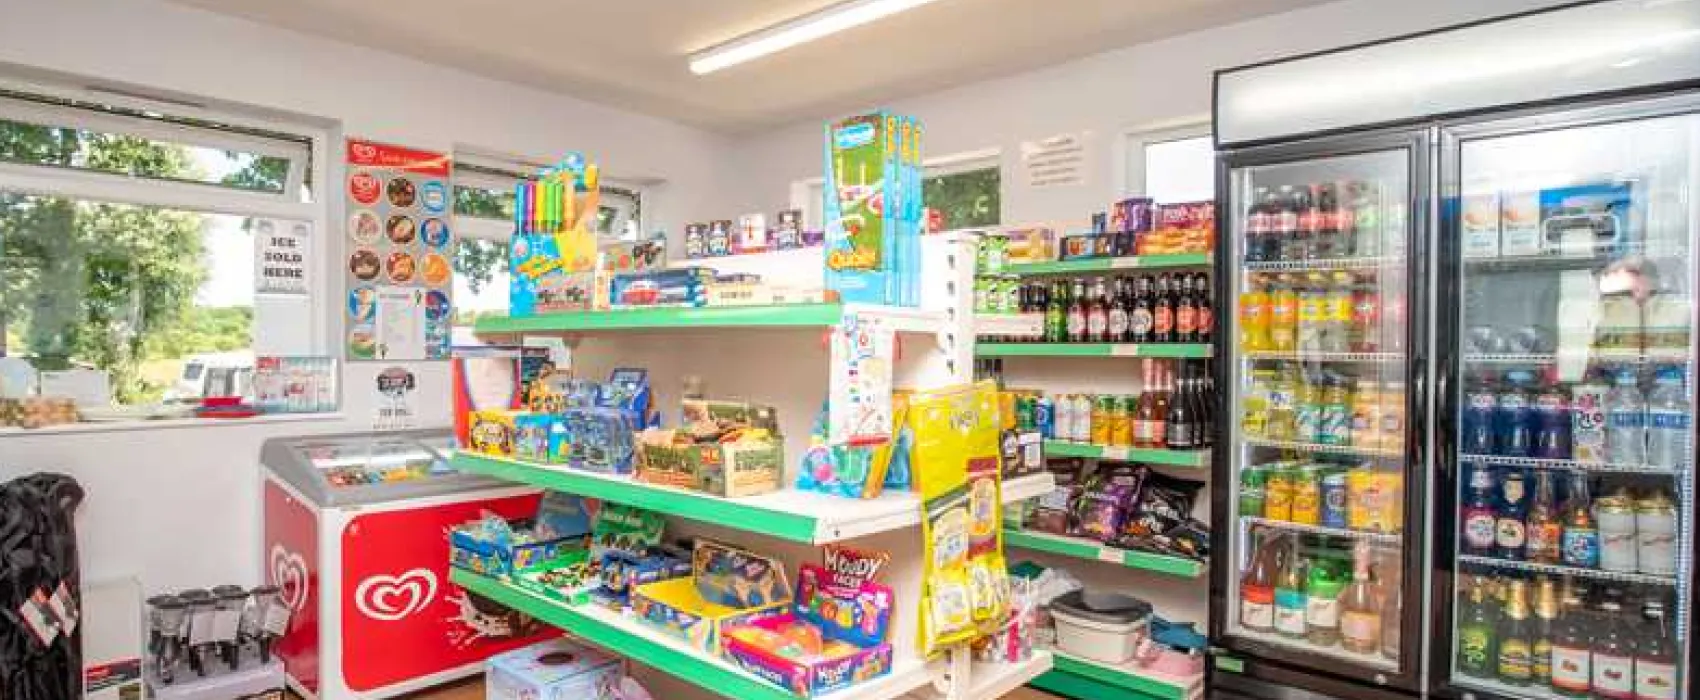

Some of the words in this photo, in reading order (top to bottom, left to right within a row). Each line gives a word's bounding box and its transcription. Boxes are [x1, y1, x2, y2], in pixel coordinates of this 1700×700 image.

[270, 236, 297, 248] ICE
[264, 252, 303, 263] SOLD
[264, 267, 303, 279] HERE
